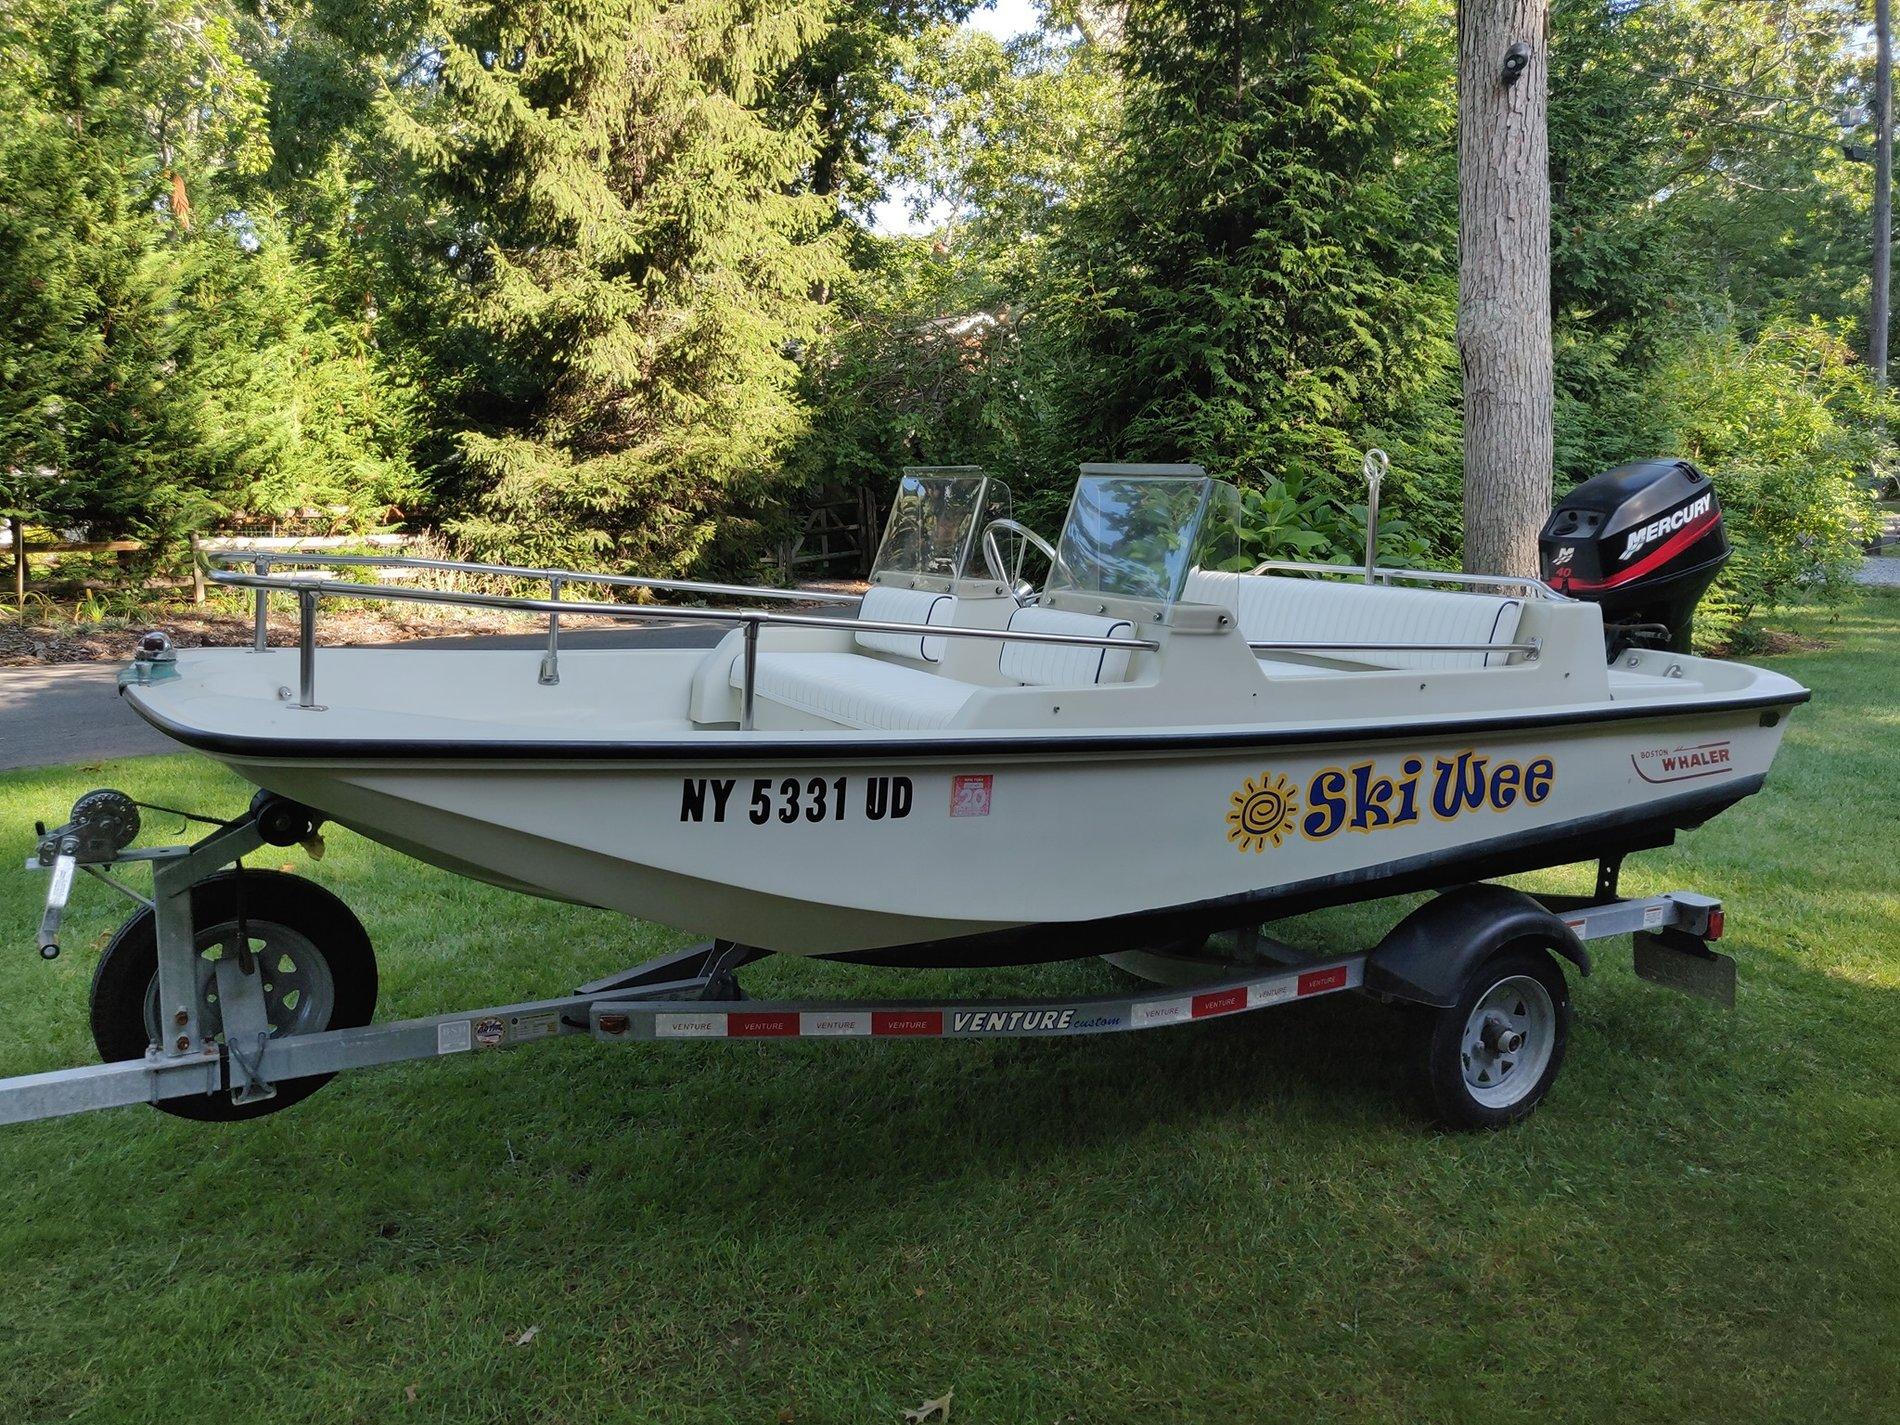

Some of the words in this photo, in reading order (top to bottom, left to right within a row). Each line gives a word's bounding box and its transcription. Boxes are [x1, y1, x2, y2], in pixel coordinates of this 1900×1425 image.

[1619, 492, 1711, 560] MERCURY
[1556, 567, 1572, 578] 40
[1641, 749, 1668, 759] BOSTON
[1662, 748, 1730, 772] WHALER
[679, 778, 736, 823] NY
[748, 776, 847, 825] 5331
[865, 776, 913, 821] UD
[959, 788, 986, 808] 20
[1308, 975, 1337, 988] VENTURE
[1258, 986, 1288, 998] VENTURE
[1205, 997, 1237, 1009] VENTURE
[1145, 1007, 1180, 1018] VENTURE
[673, 1022, 712, 1030] VENTURE
[744, 1022, 784, 1030] VENTURE
[816, 1021, 856, 1029] VENTURE
[888, 1021, 927, 1029] VENTURE
[953, 1009, 1076, 1032] VENTURE
[1074, 1016, 1121, 1028] custom
